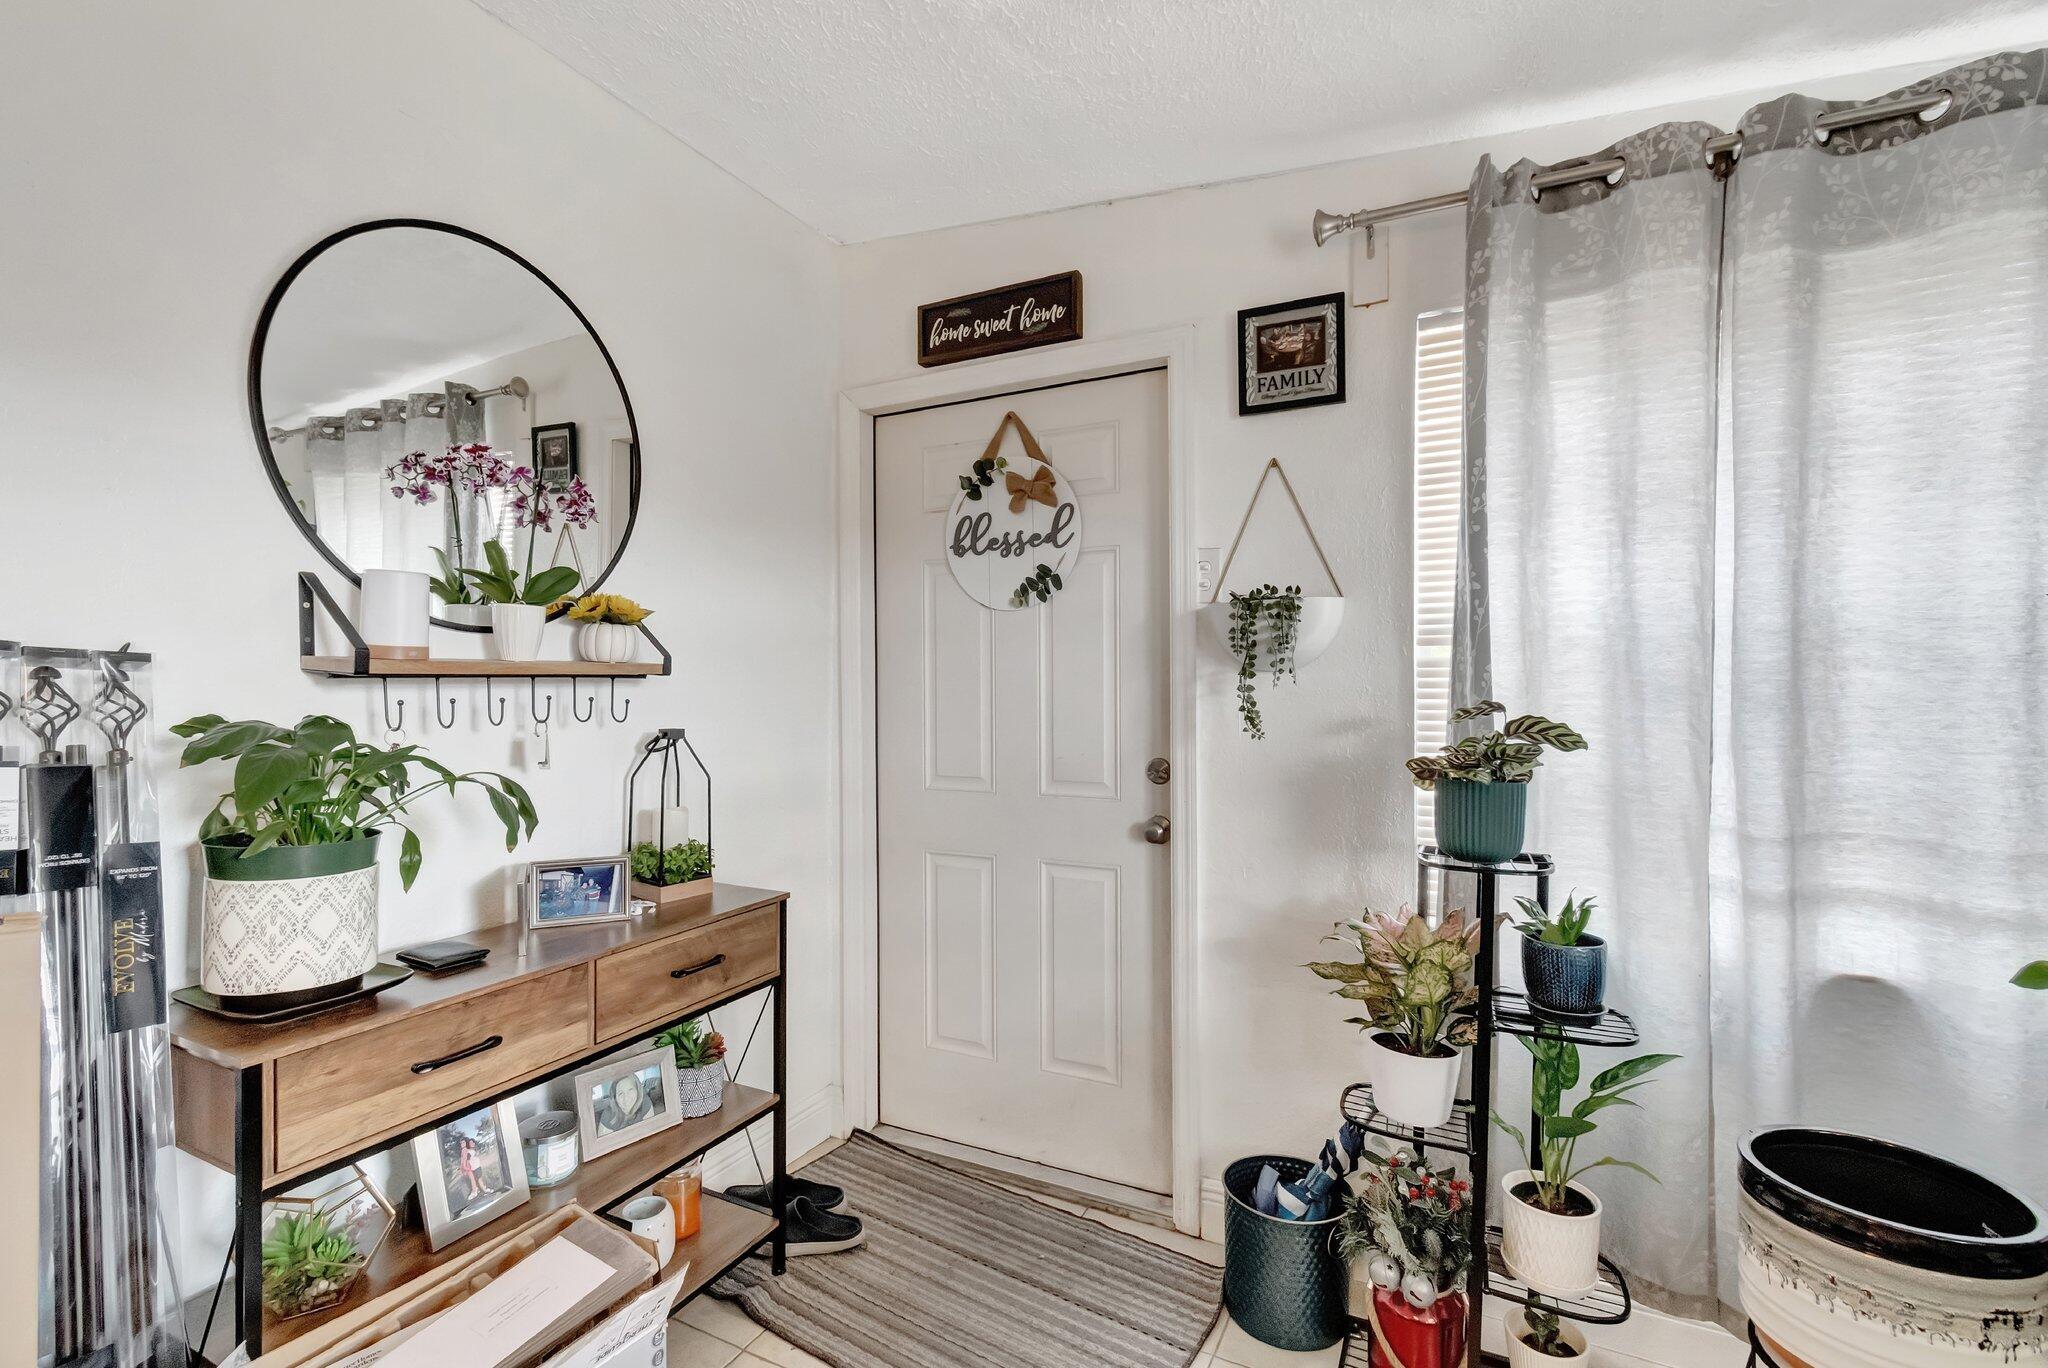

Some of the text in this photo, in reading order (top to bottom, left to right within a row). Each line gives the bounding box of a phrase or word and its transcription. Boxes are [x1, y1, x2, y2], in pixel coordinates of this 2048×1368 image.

[929, 297, 1067, 349] home sweet home
[1257, 367, 1326, 393] FAMILY
[949, 502, 1075, 558] blessed
[113, 917, 135, 997] EVOLVE
[136, 951, 156, 963] by
